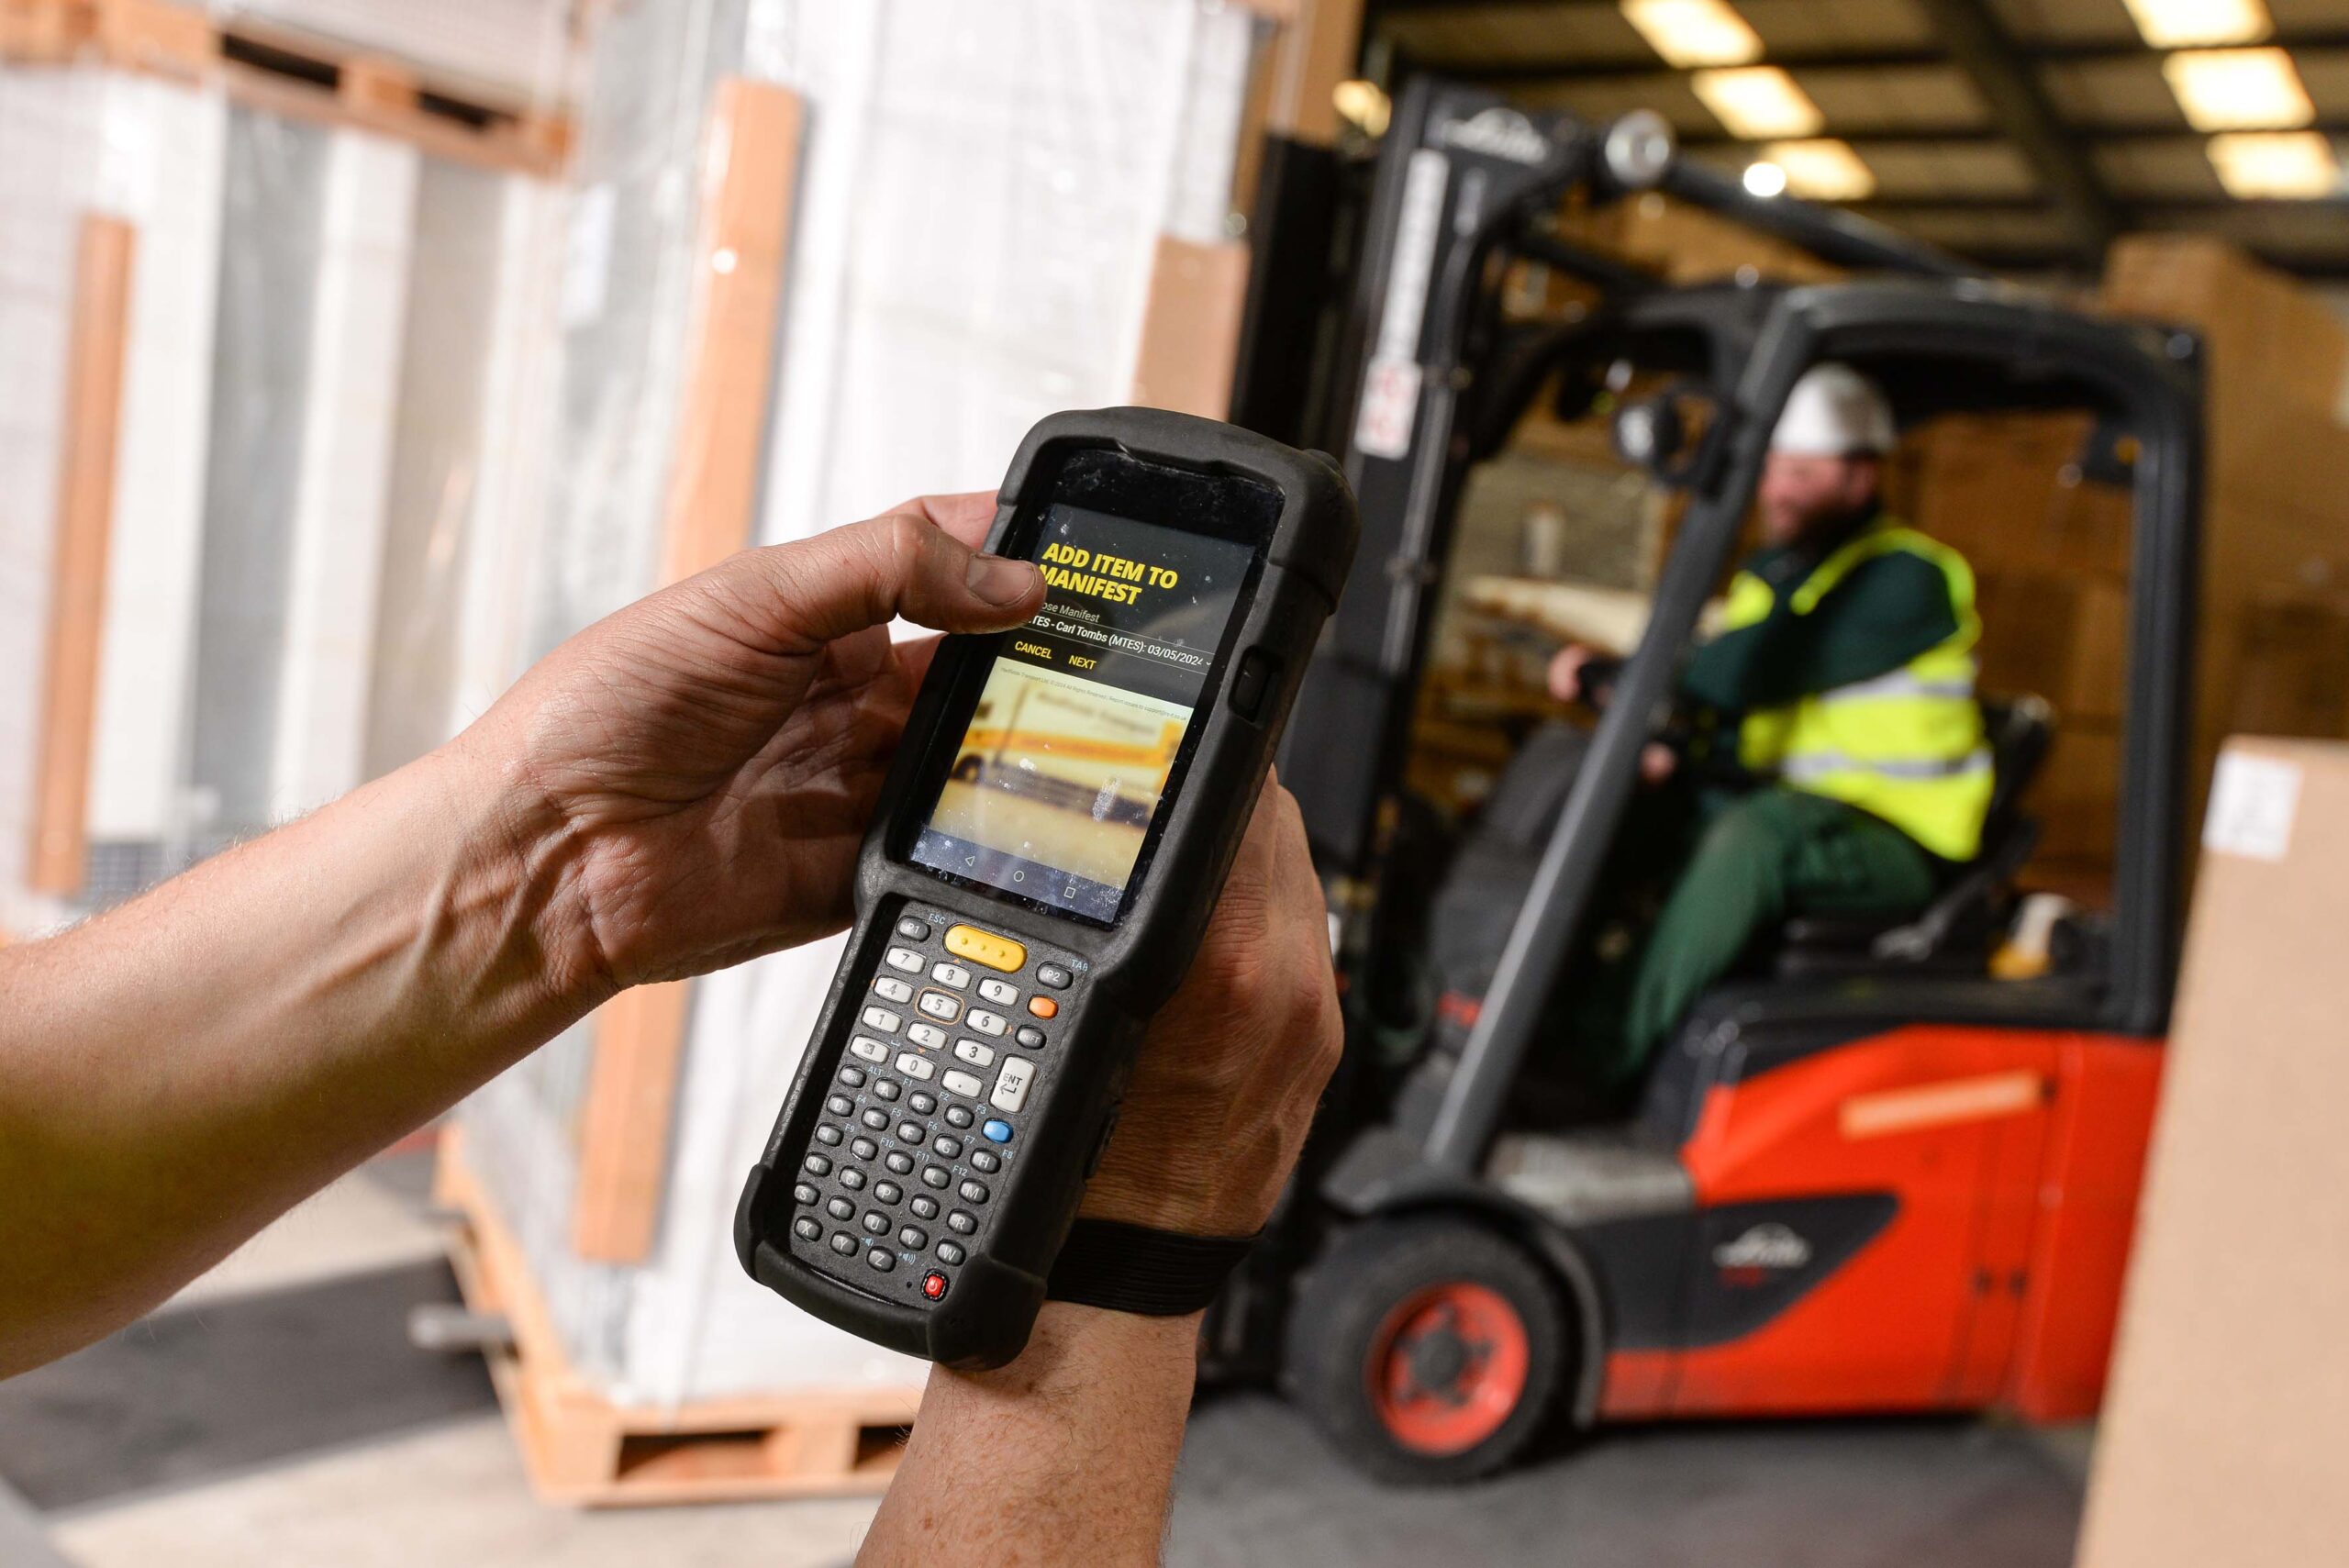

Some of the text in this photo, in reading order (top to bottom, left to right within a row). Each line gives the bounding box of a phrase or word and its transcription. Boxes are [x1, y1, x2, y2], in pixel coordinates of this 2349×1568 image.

[1041, 542, 1178, 589] ADD ITEM TO
[1038, 564, 1142, 606] MANIFEST
[1059, 605, 1100, 624] Manifest
[1029, 615, 1051, 628] TES
[1055, 621, 1076, 635] Carl
[1076, 627, 1108, 643] Tombs
[1108, 634, 1146, 654] (MTES):
[1015, 640, 1097, 671] CANCEL NEXT
[929, 913, 946, 925] ESC
[900, 953, 910, 964] 7
[1071, 959, 1088, 972] TAB
[946, 969, 955, 981] 8
[1046, 970, 1061, 983] P2
[890, 984, 898, 995] 4
[994, 984, 1002, 996] 9
[934, 998, 943, 1011] 5
[878, 1014, 885, 1026] 1
[981, 1016, 990, 1028] 6
[920, 1029, 930, 1042] 2
[969, 1046, 978, 1059] 3
[867, 1065, 884, 1076] ALT
[909, 1060, 918, 1072] 0
[903, 1078, 913, 1087] F1
[1003, 1073, 1023, 1085] ENT
[880, 1087, 889, 1097] A
[939, 1092, 950, 1101] F2
[856, 1095, 866, 1104] F4
[917, 1098, 925, 1109] B
[892, 1108, 902, 1118] F5
[975, 1105, 987, 1115] F3
[870, 1113, 880, 1127] E
[953, 1111, 963, 1123] C
[844, 1123, 855, 1132] F9
[928, 1121, 938, 1130] F6
[906, 1125, 915, 1139] F
[880, 1138, 895, 1148] F10
[964, 1135, 975, 1144] F7
[858, 1144, 867, 1155] J
[941, 1141, 952, 1154] G
[916, 1151, 930, 1162] F11
[1002, 1150, 1013, 1160] F8
[811, 1159, 821, 1172] N
[893, 1157, 904, 1171] K
[978, 1156, 990, 1169] H
[952, 1165, 968, 1177] F12
[930, 1172, 938, 1184] L
[799, 1189, 808, 1200] S
[882, 1189, 891, 1198] P
[965, 1186, 980, 1200] M
[835, 1200, 845, 1215] T
[918, 1202, 929, 1216] Q
[801, 1222, 813, 1236] X
[871, 1218, 880, 1230] U
[955, 1217, 966, 1230] R
[839, 1237, 849, 1251] Y
[908, 1232, 918, 1245] V
[874, 1253, 885, 1267] Z
[944, 1248, 957, 1262] W
